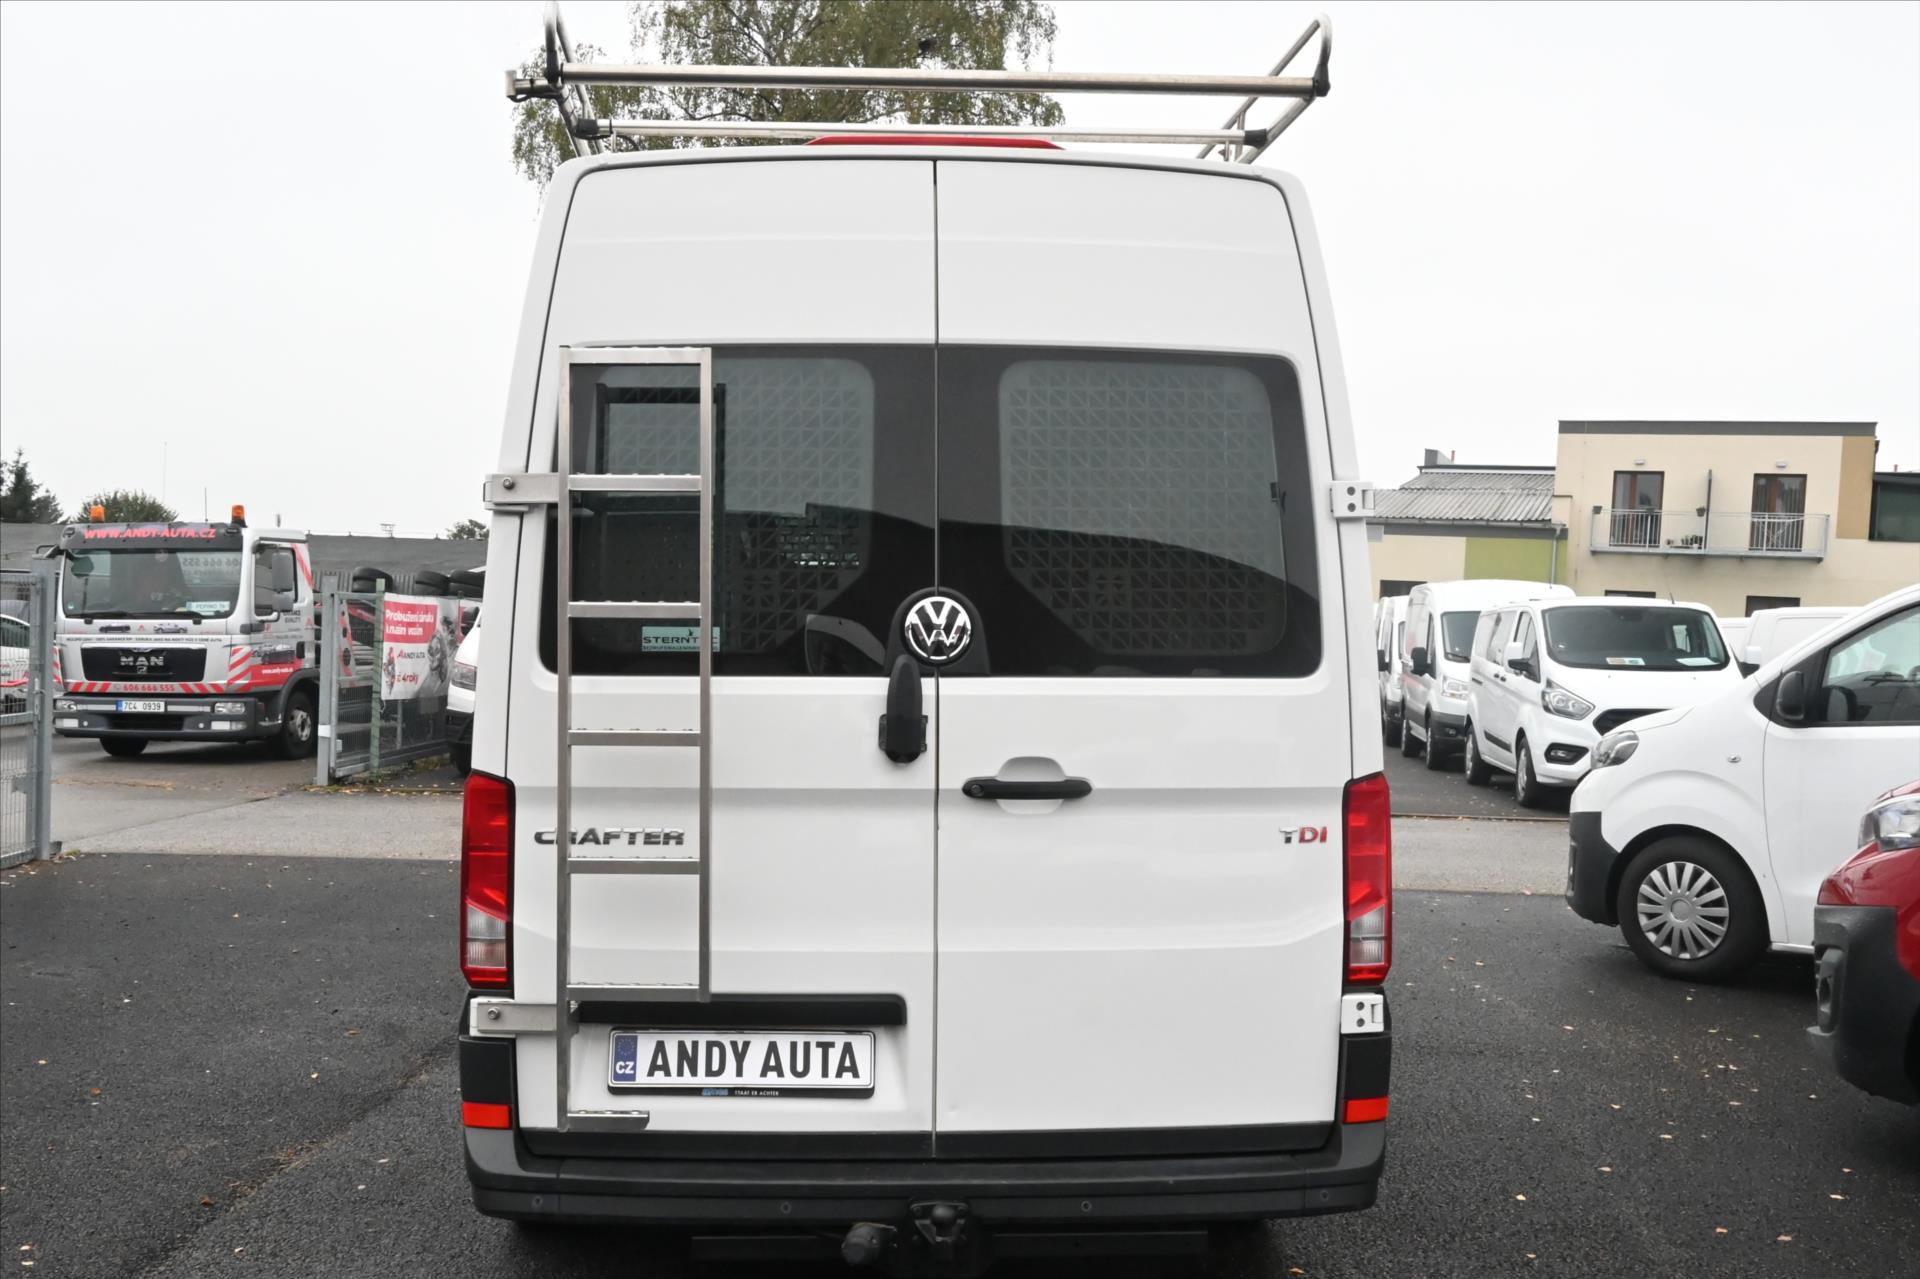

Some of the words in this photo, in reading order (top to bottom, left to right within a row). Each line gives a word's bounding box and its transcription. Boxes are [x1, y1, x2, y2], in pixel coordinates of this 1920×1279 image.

[83, 527, 217, 539] WWW.ANDY-AUTA.CZ
[642, 635, 719, 645] STERNT
[120, 656, 164, 666] MAN
[123, 683, 140, 692] 606
[159, 683, 176, 692] 555
[142, 702, 162, 711] 0939
[1278, 826, 1328, 844] TDI
[615, 1060, 635, 1075] CZ
[646, 1039, 752, 1078] ANDY
[759, 1040, 861, 1079] AUTA
